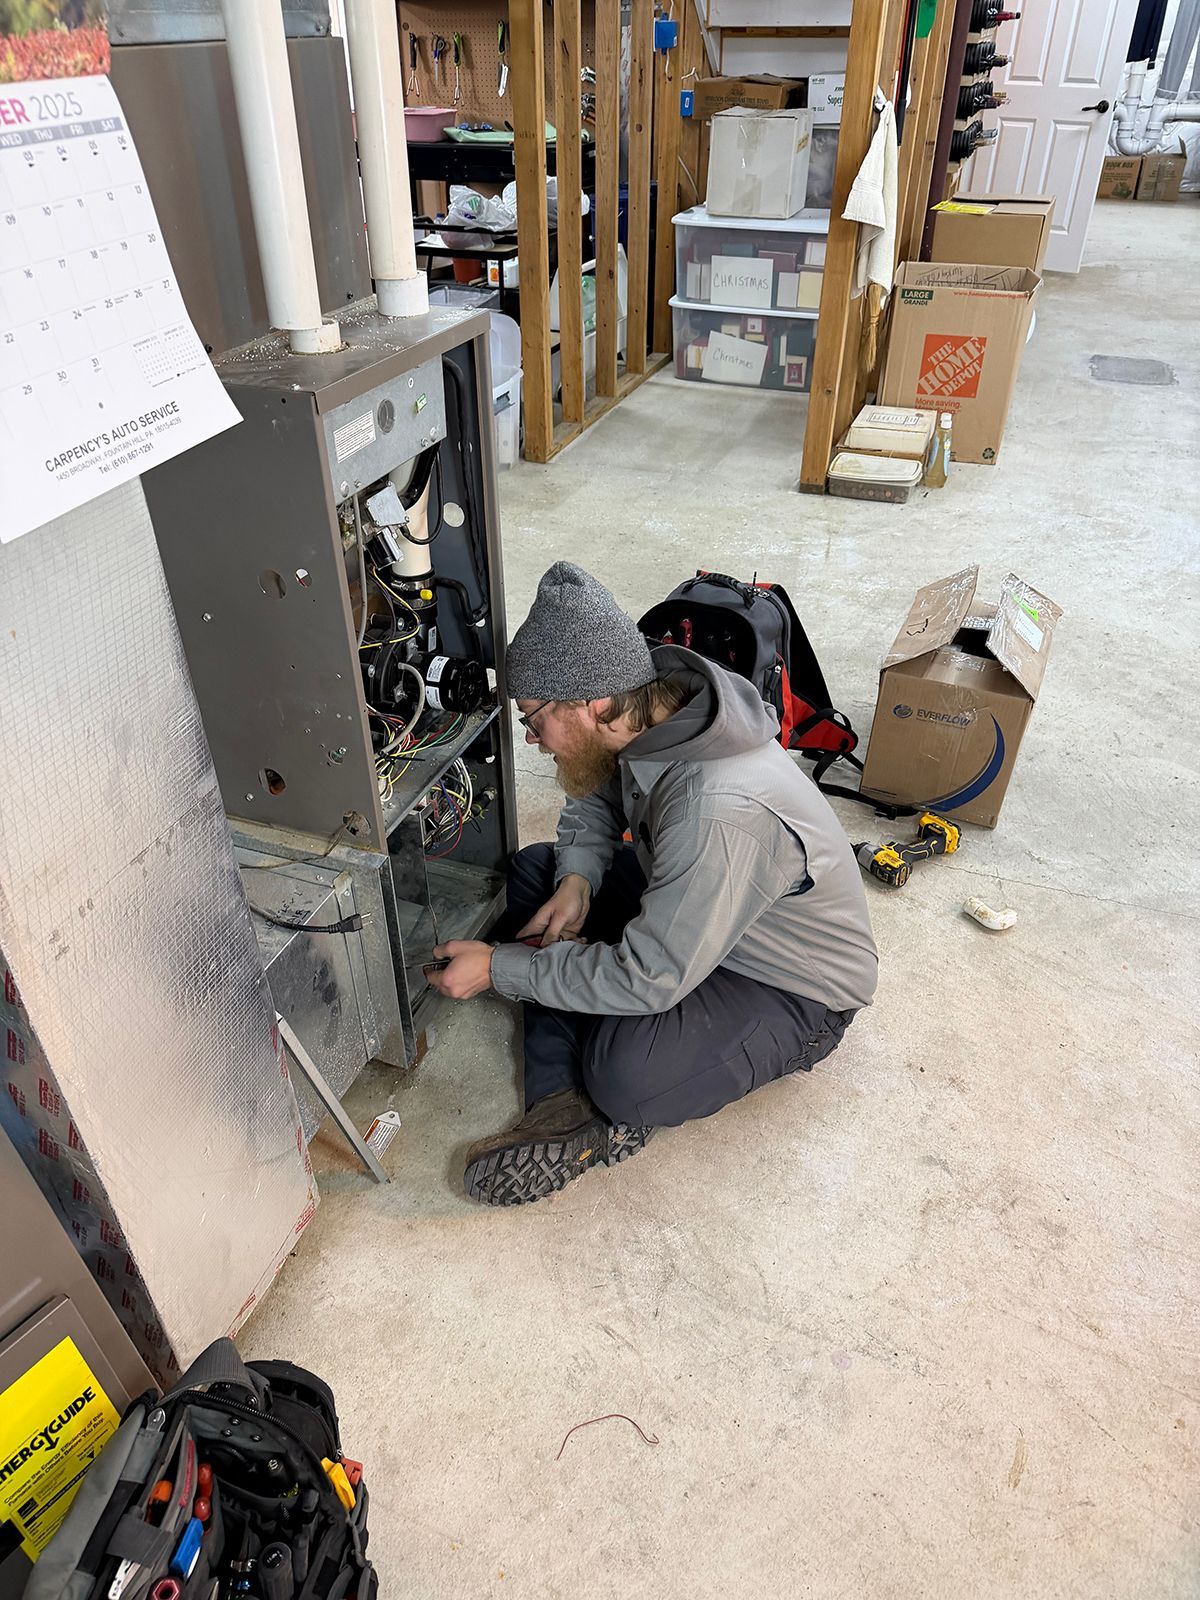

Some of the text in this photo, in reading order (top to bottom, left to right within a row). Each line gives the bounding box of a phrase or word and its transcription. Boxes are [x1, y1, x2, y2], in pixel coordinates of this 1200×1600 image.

[0, 92, 82, 125] ER 2025
[34, 129, 54, 141] THU
[70, 124, 85, 136] FRI
[101, 119, 116, 131] SAT
[43, 206, 51, 217] 10
[77, 199, 84, 208] 11
[107, 192, 114, 201] 12
[134, 185, 142, 194] 13
[23, 269, 33, 279] 16
[58, 259, 66, 269] 17
[148, 234, 156, 243] 20
[713, 273, 769, 290] CHRISTMAS
[904, 290, 930, 299] LARGE
[4, 333, 14, 344] 22
[40, 321, 50, 331] 23
[73, 310, 82, 320] 24
[105, 299, 114, 309] 25
[134, 289, 143, 298] 26
[162, 280, 171, 289] 27
[712, 348, 754, 369] Christmas
[919, 337, 984, 394] HOME
[928, 341, 955, 365] THE
[22, 358, 100, 396] 29 30 31
[940, 360, 981, 397] DEPOT
[915, 398, 934, 406] More
[45, 401, 179, 472] CARPENCY'S AUTO SERVICE
[916, 709, 971, 726] EVERFLOW
[0, 1386, 96, 1485] NERGYGUIDE
